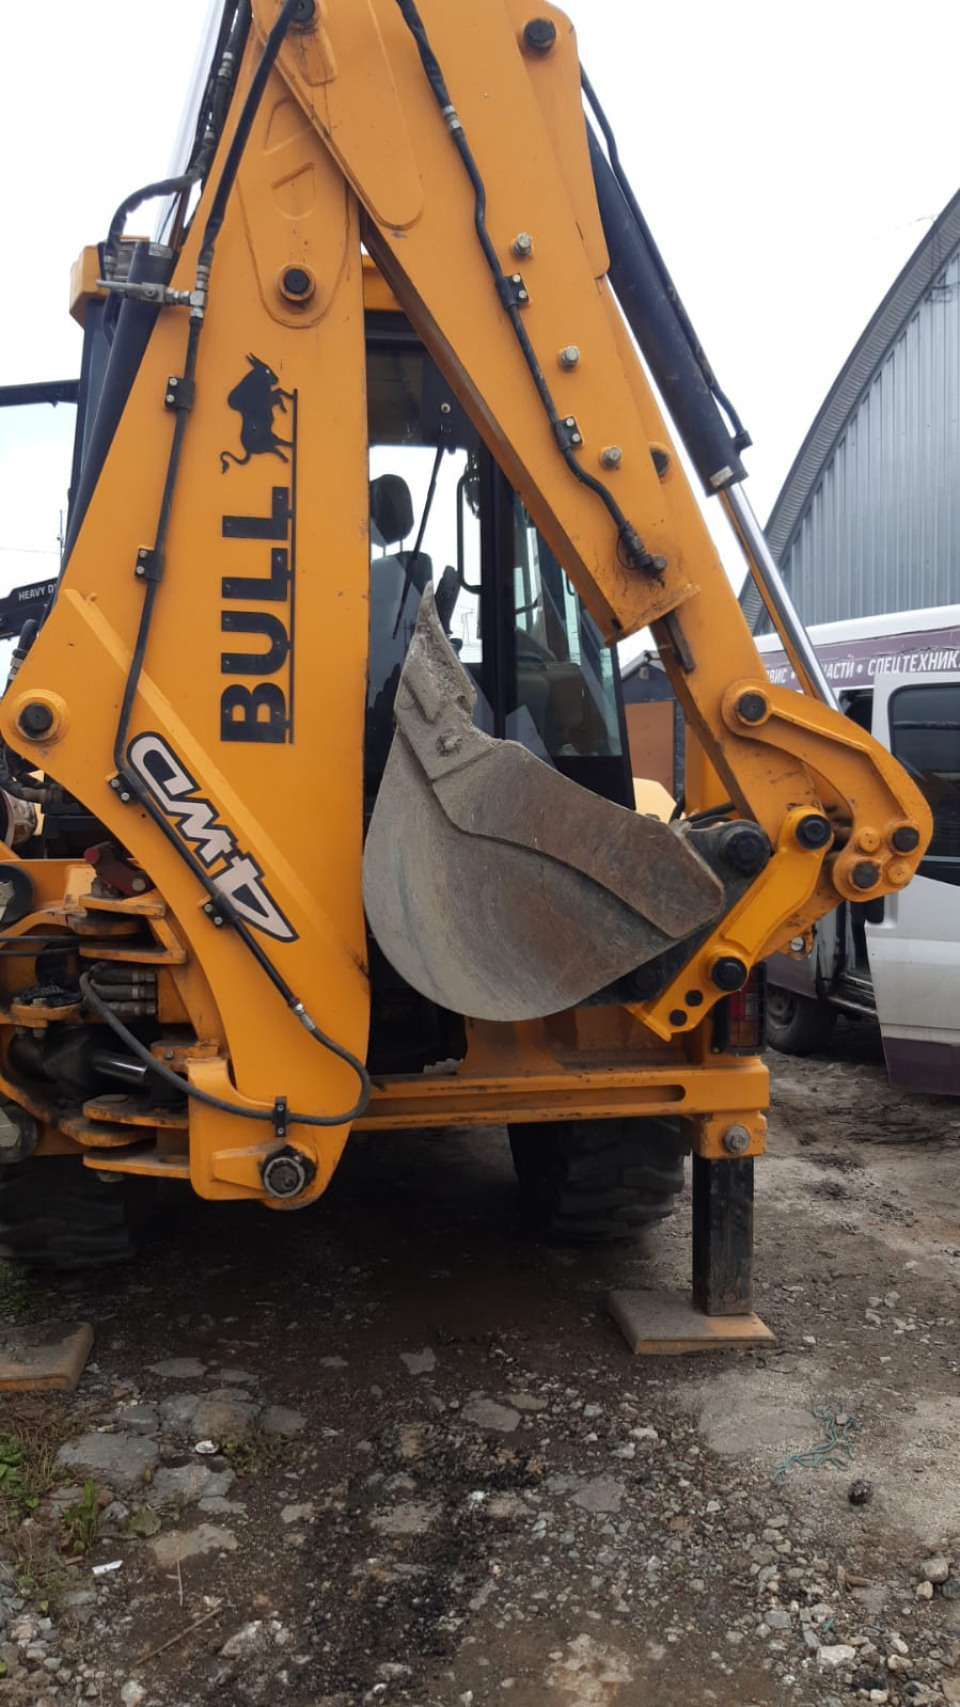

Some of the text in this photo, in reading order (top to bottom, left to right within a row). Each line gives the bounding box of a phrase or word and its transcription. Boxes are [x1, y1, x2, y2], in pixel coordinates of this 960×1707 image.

[18, 586, 46, 601] HEAVY
[220, 486, 289, 744] BULL
[766, 667, 787, 684] ВИС
[867, 650, 960, 676] СПЕЦТЕХНИК
